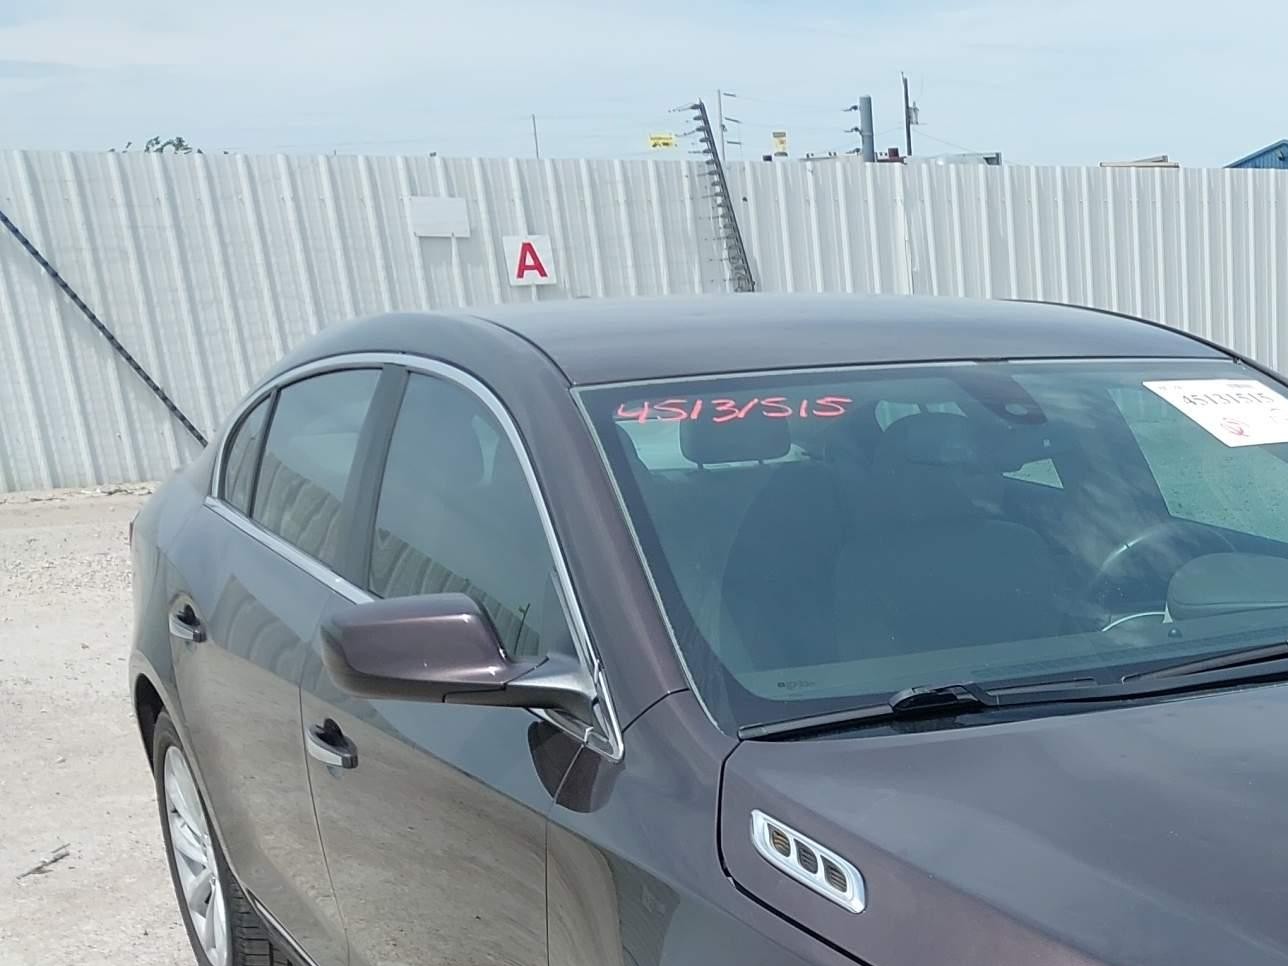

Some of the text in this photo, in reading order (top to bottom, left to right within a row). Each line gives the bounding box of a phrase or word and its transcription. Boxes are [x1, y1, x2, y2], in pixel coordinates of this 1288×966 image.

[516, 242, 549, 279] A
[617, 396, 853, 424] 45131515
[1181, 391, 1275, 407] 45131515
